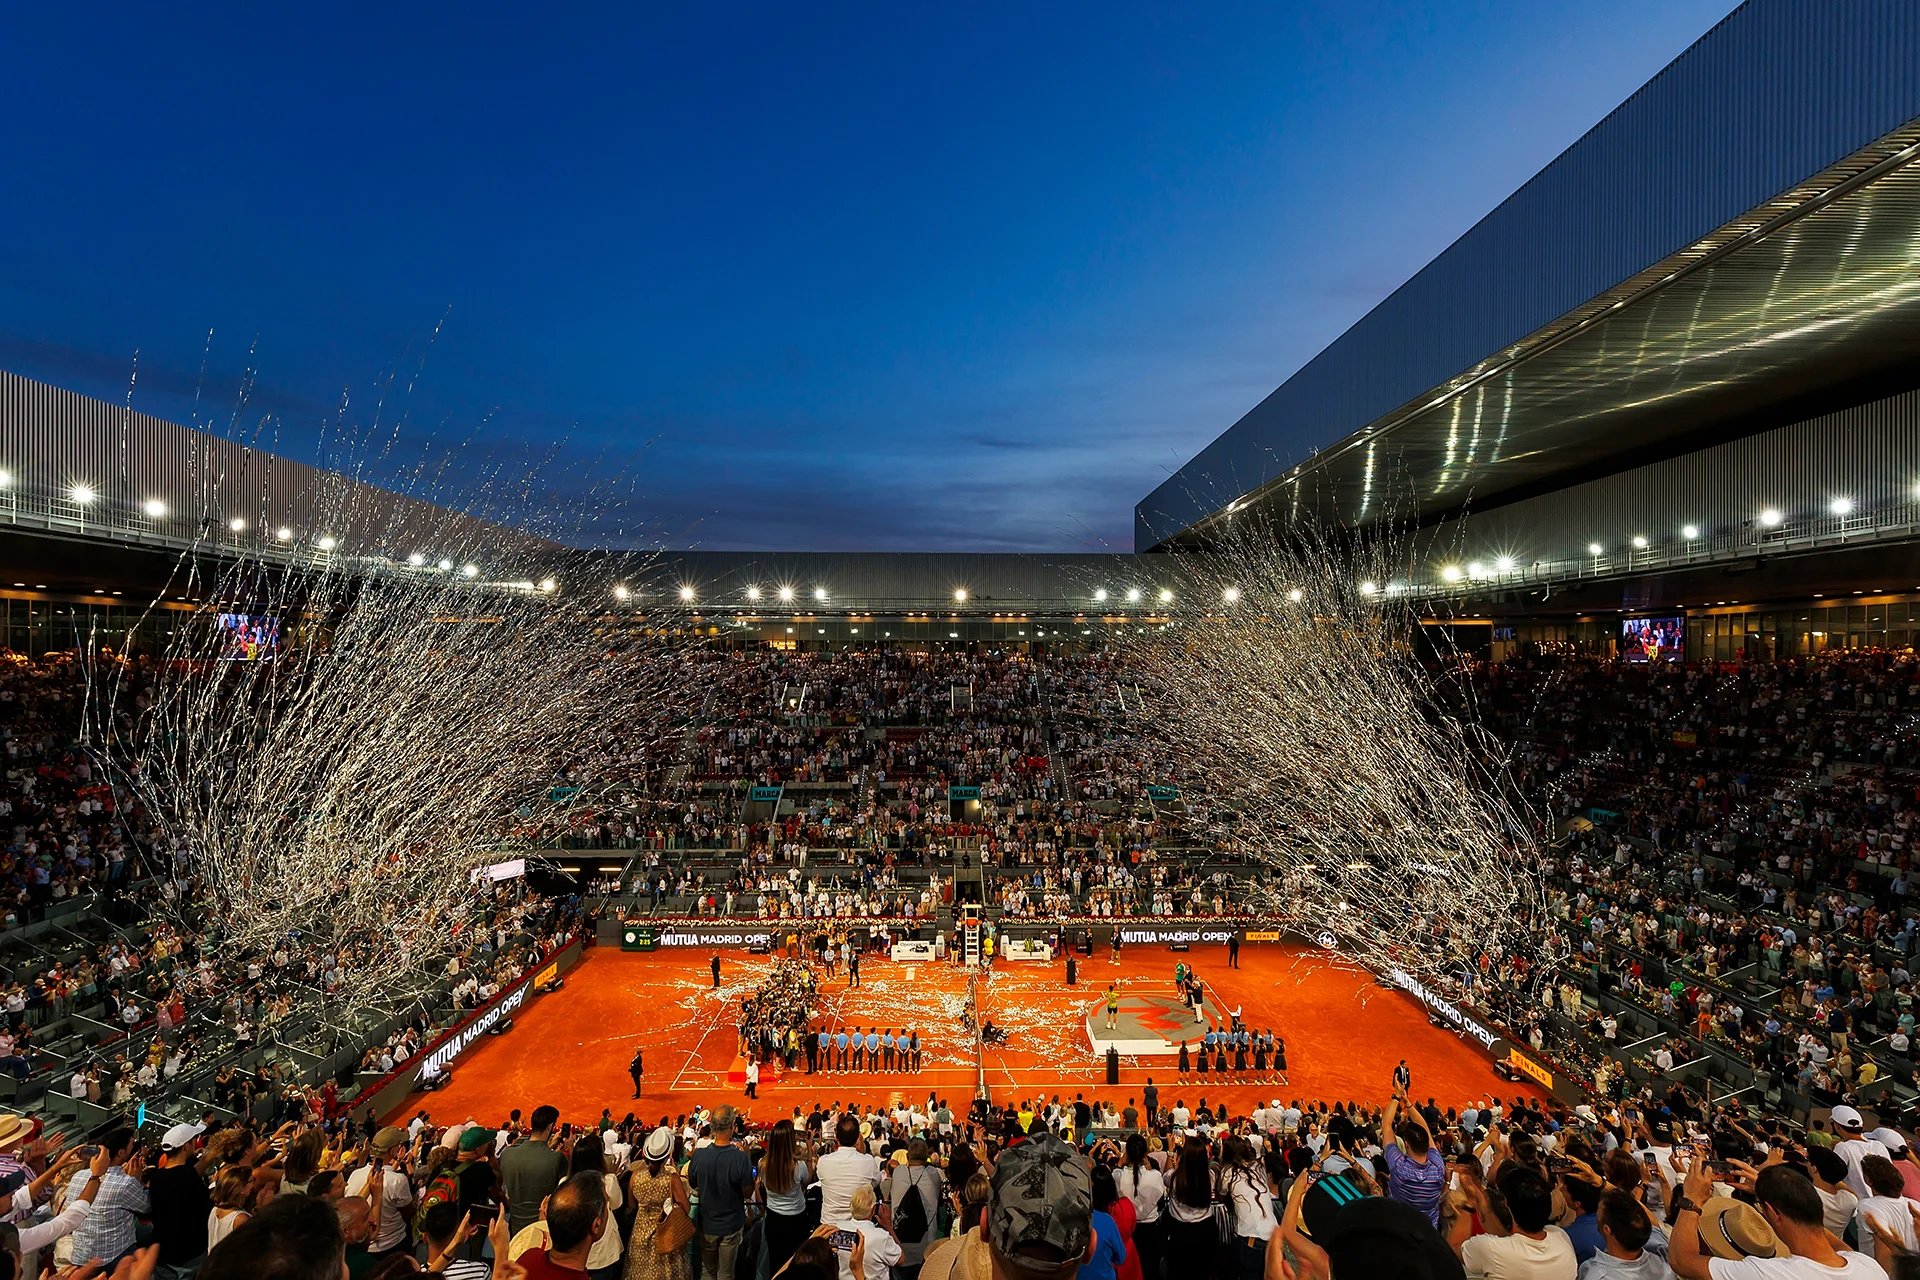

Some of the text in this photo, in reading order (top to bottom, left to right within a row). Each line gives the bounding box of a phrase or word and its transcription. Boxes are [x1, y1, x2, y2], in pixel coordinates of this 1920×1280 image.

[953, 789, 978, 797] MARCA
[660, 934, 699, 946] MUTUA
[700, 934, 742, 944] MADRID
[1120, 931, 1231, 943] MUTUA MADRID OPEN
[1425, 990, 1462, 1024] MADRID
[1464, 1017, 1494, 1045] OPEN
[422, 988, 525, 1080] MUTUA MADRID OPEN
[1515, 1055, 1547, 1081] FINALS
